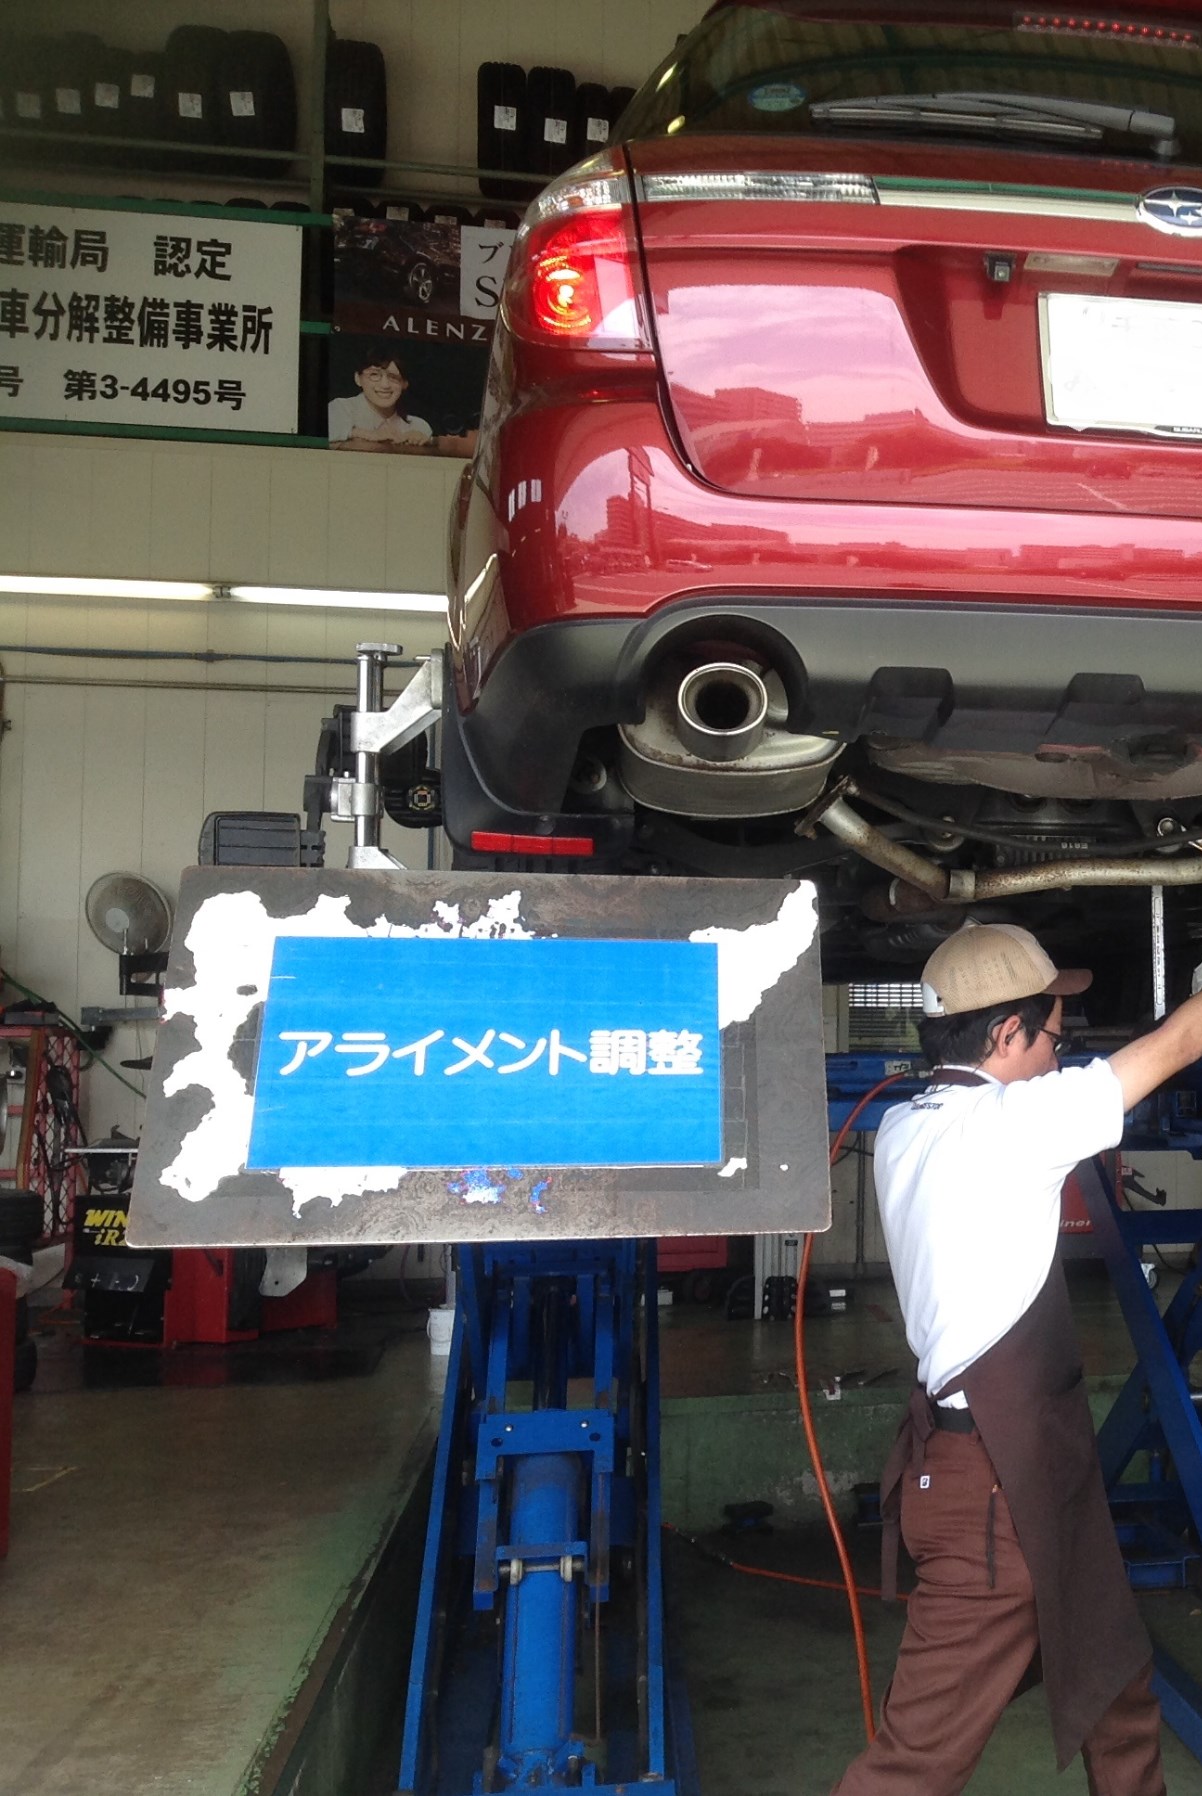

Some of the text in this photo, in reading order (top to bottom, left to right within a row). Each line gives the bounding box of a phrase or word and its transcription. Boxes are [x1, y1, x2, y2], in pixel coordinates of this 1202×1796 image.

[0, 222, 233, 282] 運輸局 認定
[0, 287, 274, 355] 車分解整備事業所
[382, 315, 488, 341] ALENZ
[63, 369, 247, 411] 第3-4495号
[278, 1028, 704, 1077] アライメント調整
